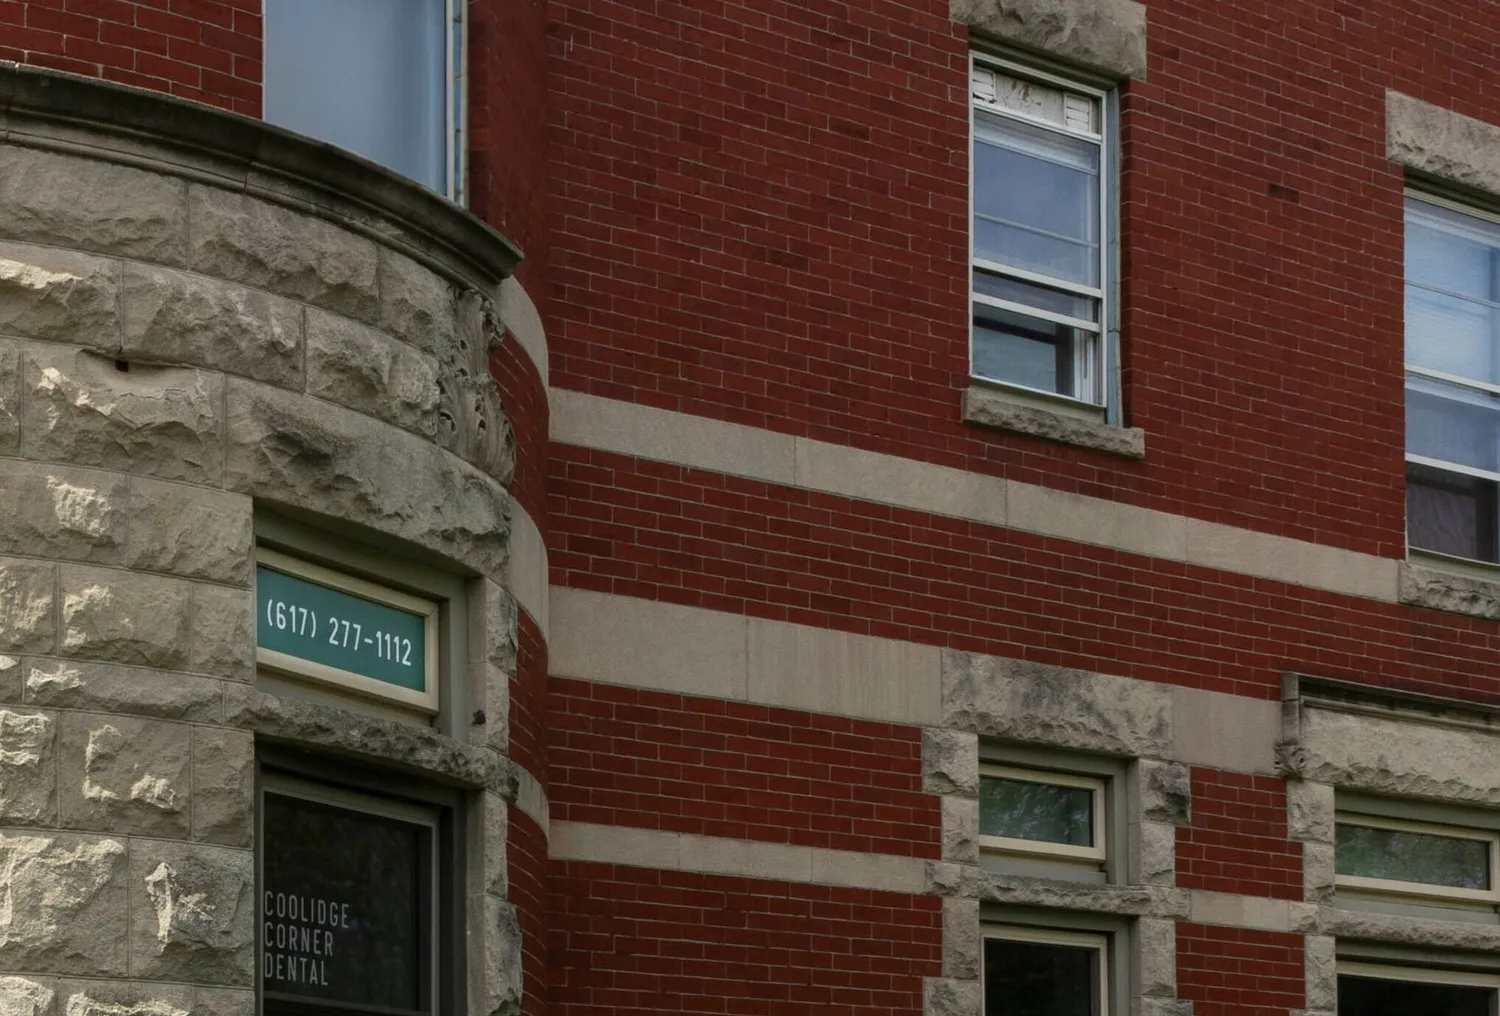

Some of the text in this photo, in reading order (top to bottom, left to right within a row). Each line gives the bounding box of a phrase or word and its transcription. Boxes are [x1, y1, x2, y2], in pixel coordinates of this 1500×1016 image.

[266, 599, 412, 667] (617) 277-1112
[264, 890, 349, 928] COOLIDGE
[264, 921, 333, 956] CORNER
[264, 952, 328, 986] DENTAL
